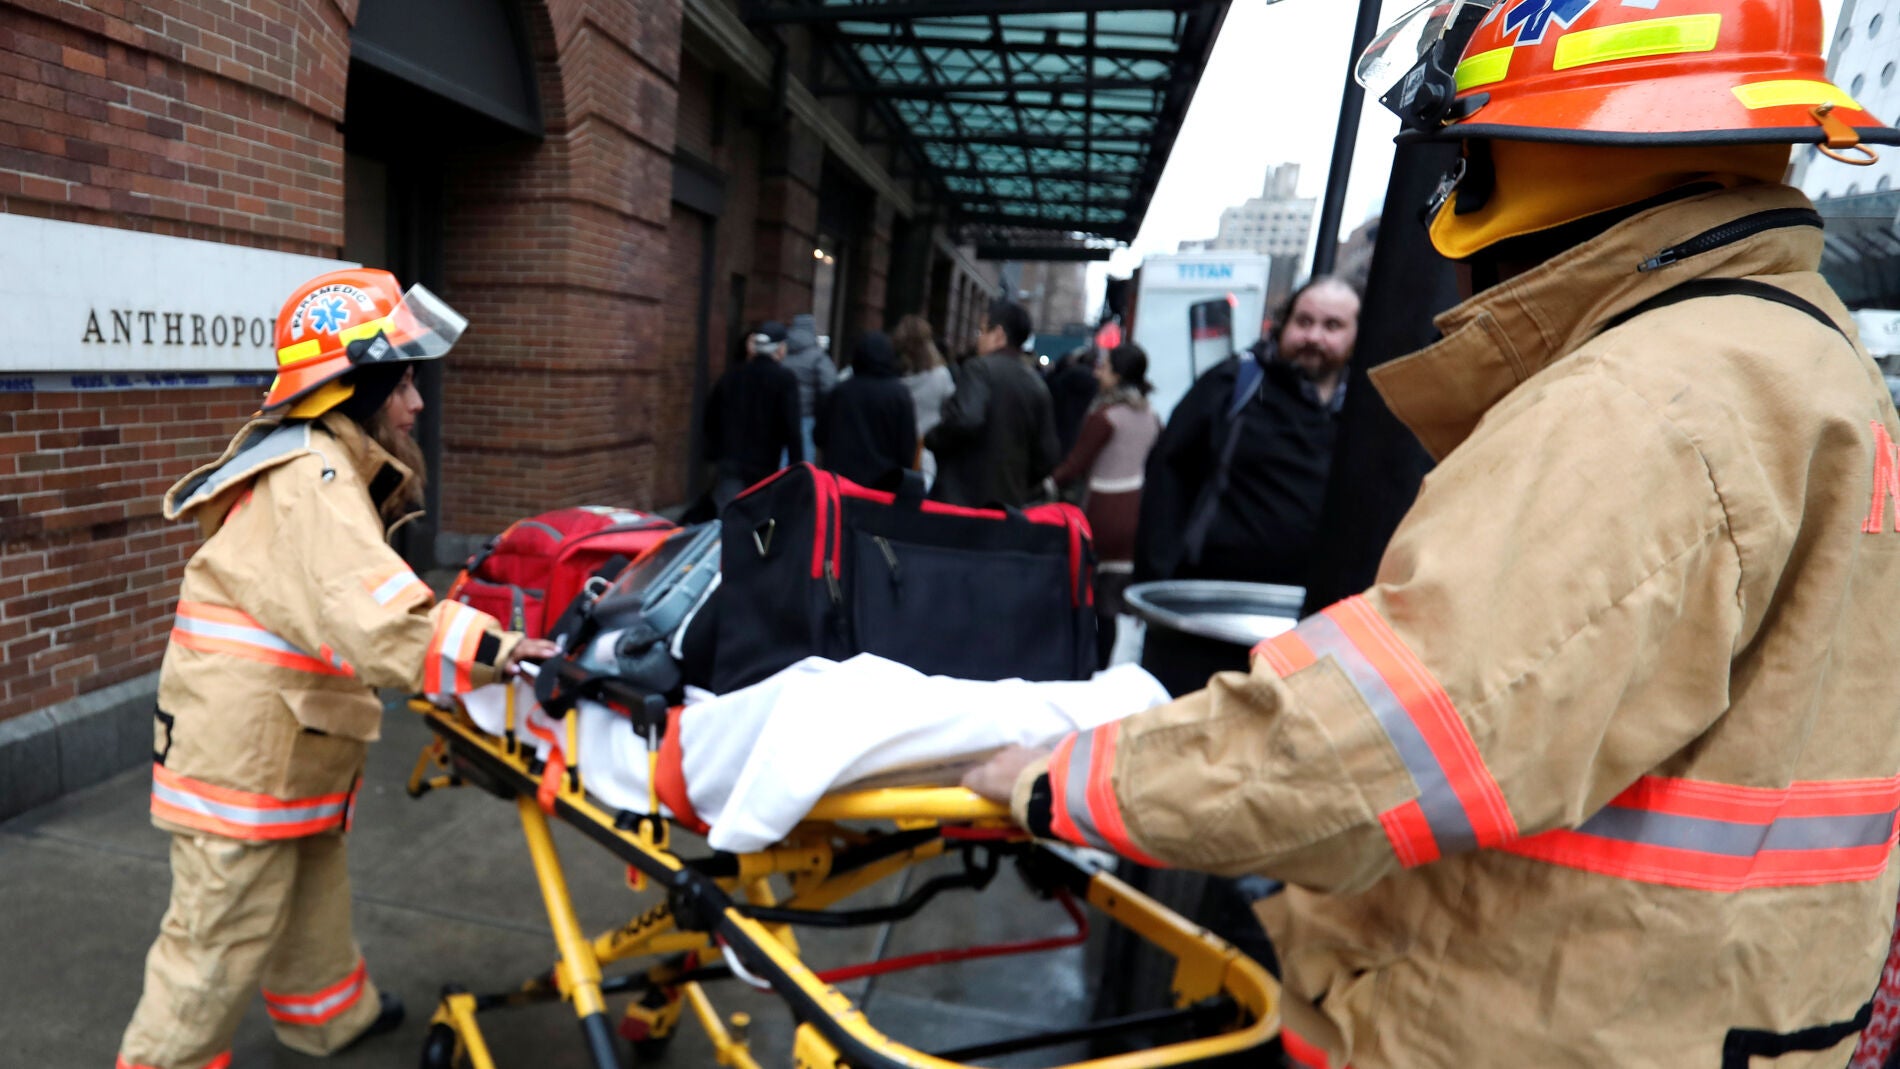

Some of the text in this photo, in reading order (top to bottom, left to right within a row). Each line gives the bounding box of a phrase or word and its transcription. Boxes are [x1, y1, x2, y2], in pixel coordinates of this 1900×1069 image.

[1178, 263, 1233, 279] TITAN
[293, 285, 367, 328] PARAMEDIC
[81, 307, 276, 348] ANTHROPO
